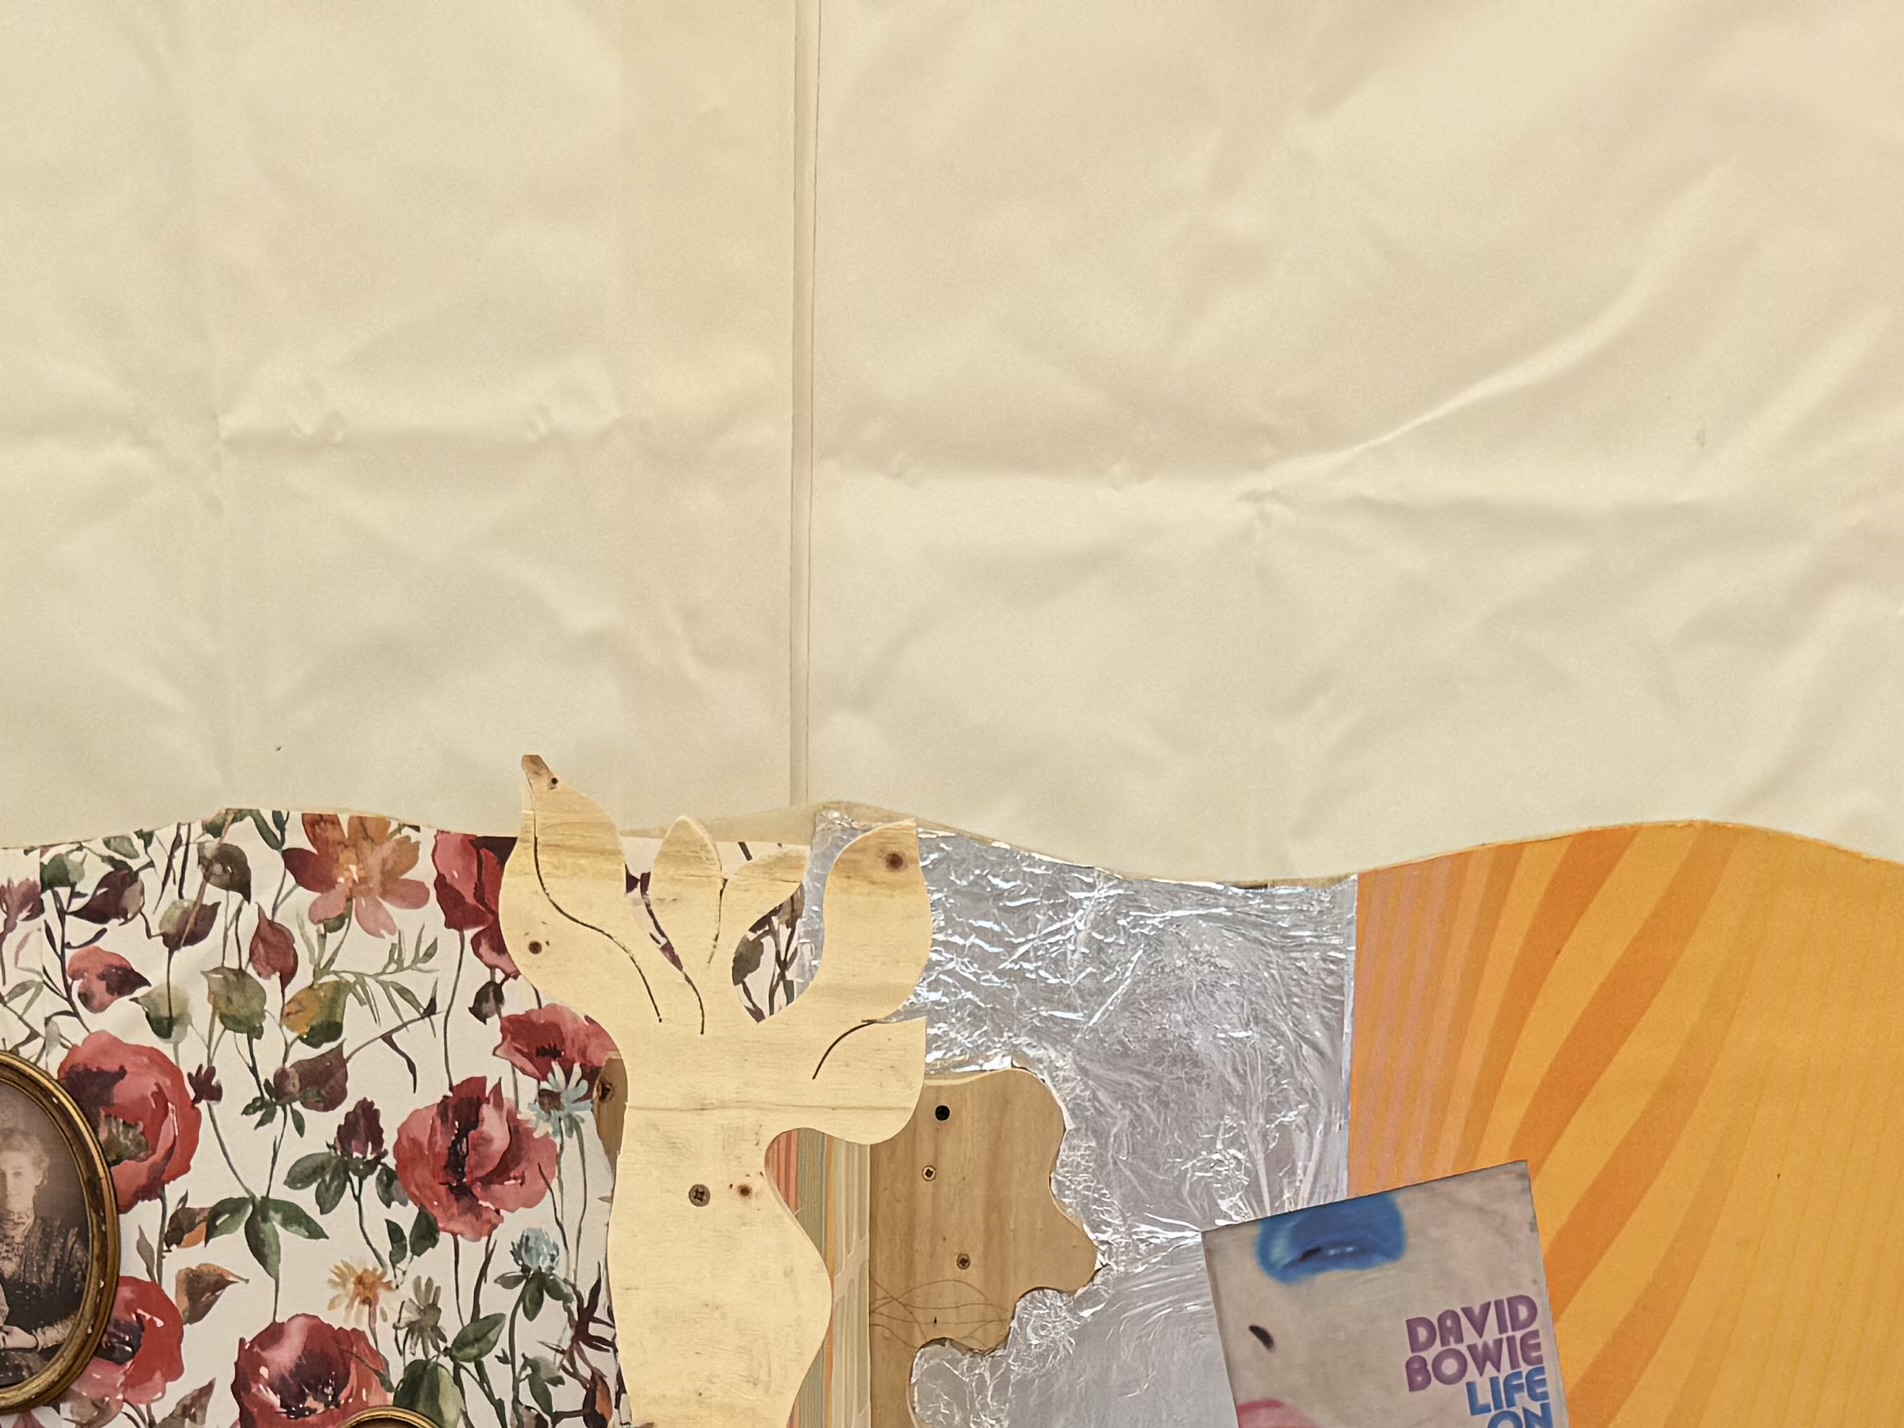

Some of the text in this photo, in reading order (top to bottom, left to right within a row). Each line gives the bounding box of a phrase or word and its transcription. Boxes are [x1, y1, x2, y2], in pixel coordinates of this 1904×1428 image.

[1405, 1294, 1538, 1354] DAVID
[1405, 1329, 1544, 1393] BOWIE
[1465, 1366, 1550, 1416] LIFE
